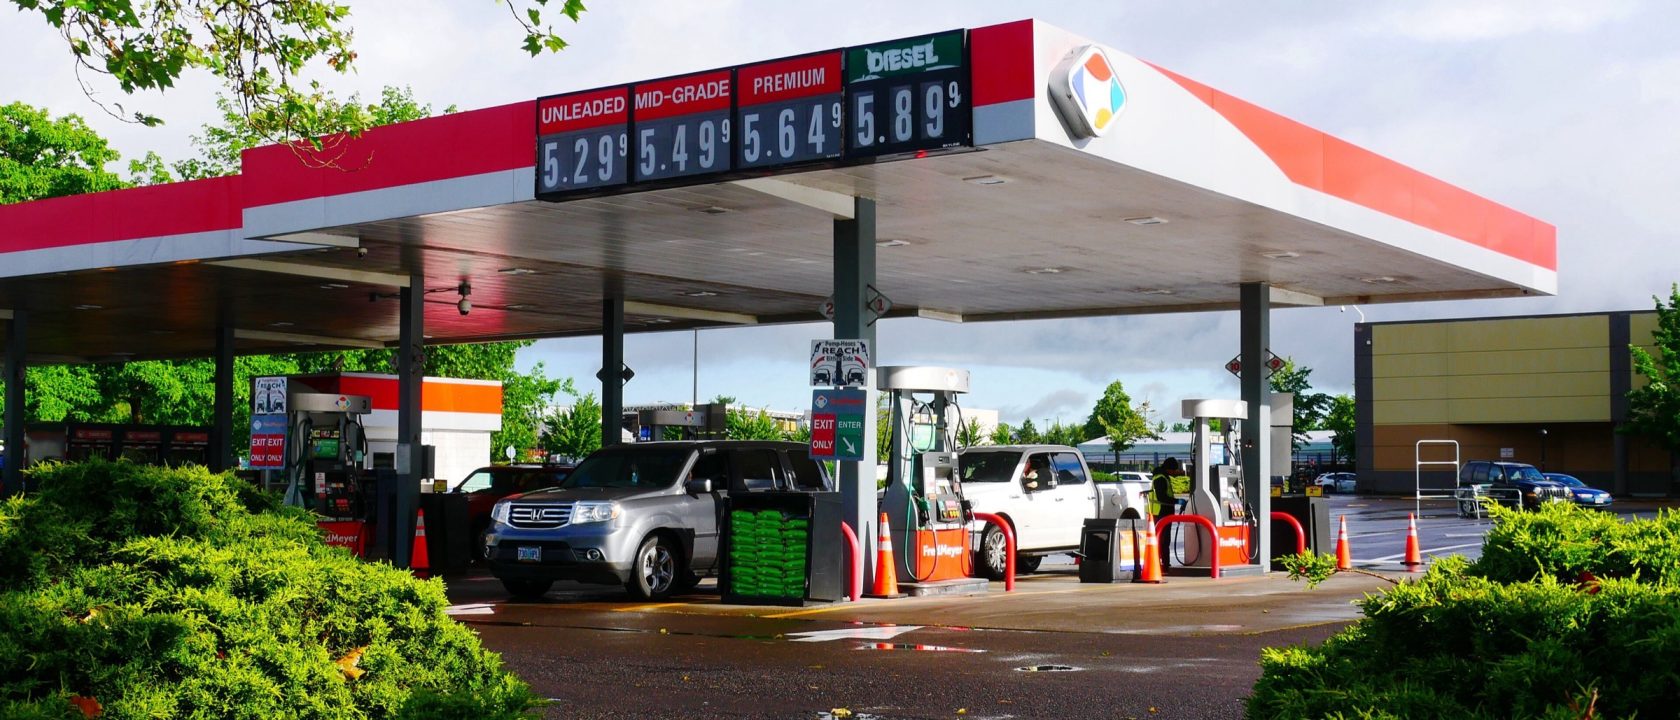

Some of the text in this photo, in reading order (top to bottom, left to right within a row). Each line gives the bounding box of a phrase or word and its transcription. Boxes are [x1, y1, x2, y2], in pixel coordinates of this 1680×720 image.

[865, 40, 939, 73] DIESEL
[753, 67, 825, 95] PREMIUM
[635, 80, 729, 110] MID-GRADE
[542, 96, 625, 124] UNLEADED
[825, 303, 833, 315] 2
[877, 299, 885, 311] 1
[822, 347, 860, 355] REACH
[1230, 362, 1240, 371] 10
[1272, 359, 1281, 369] 9
[814, 420, 834, 429] EXIT
[838, 421, 862, 429] ENTER
[252, 438, 266, 446] EXIT
[267, 438, 283, 446] EXIT
[812, 440, 833, 448] ONLY
[325, 533, 358, 544] dMeyer
